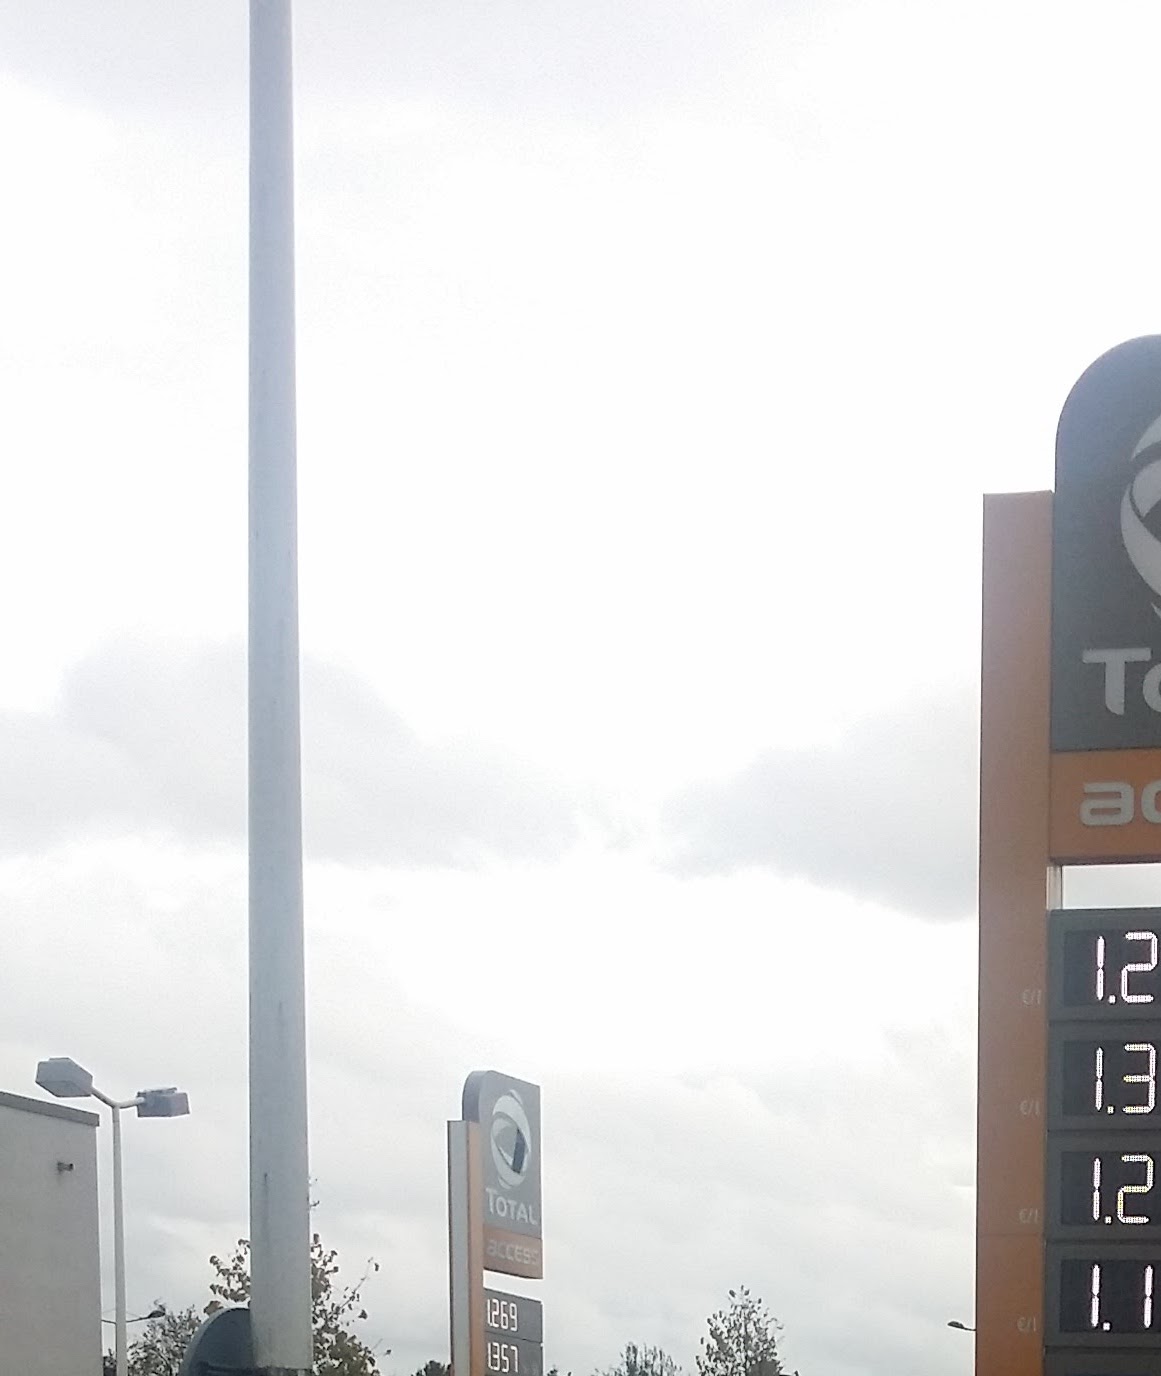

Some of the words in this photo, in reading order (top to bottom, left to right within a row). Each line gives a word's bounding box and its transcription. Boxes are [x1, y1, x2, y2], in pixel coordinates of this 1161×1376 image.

[485, 1187, 538, 1226] TOTAL
[487, 1299, 518, 1332] 1.269
[487, 1342, 519, 1373] 1.357
